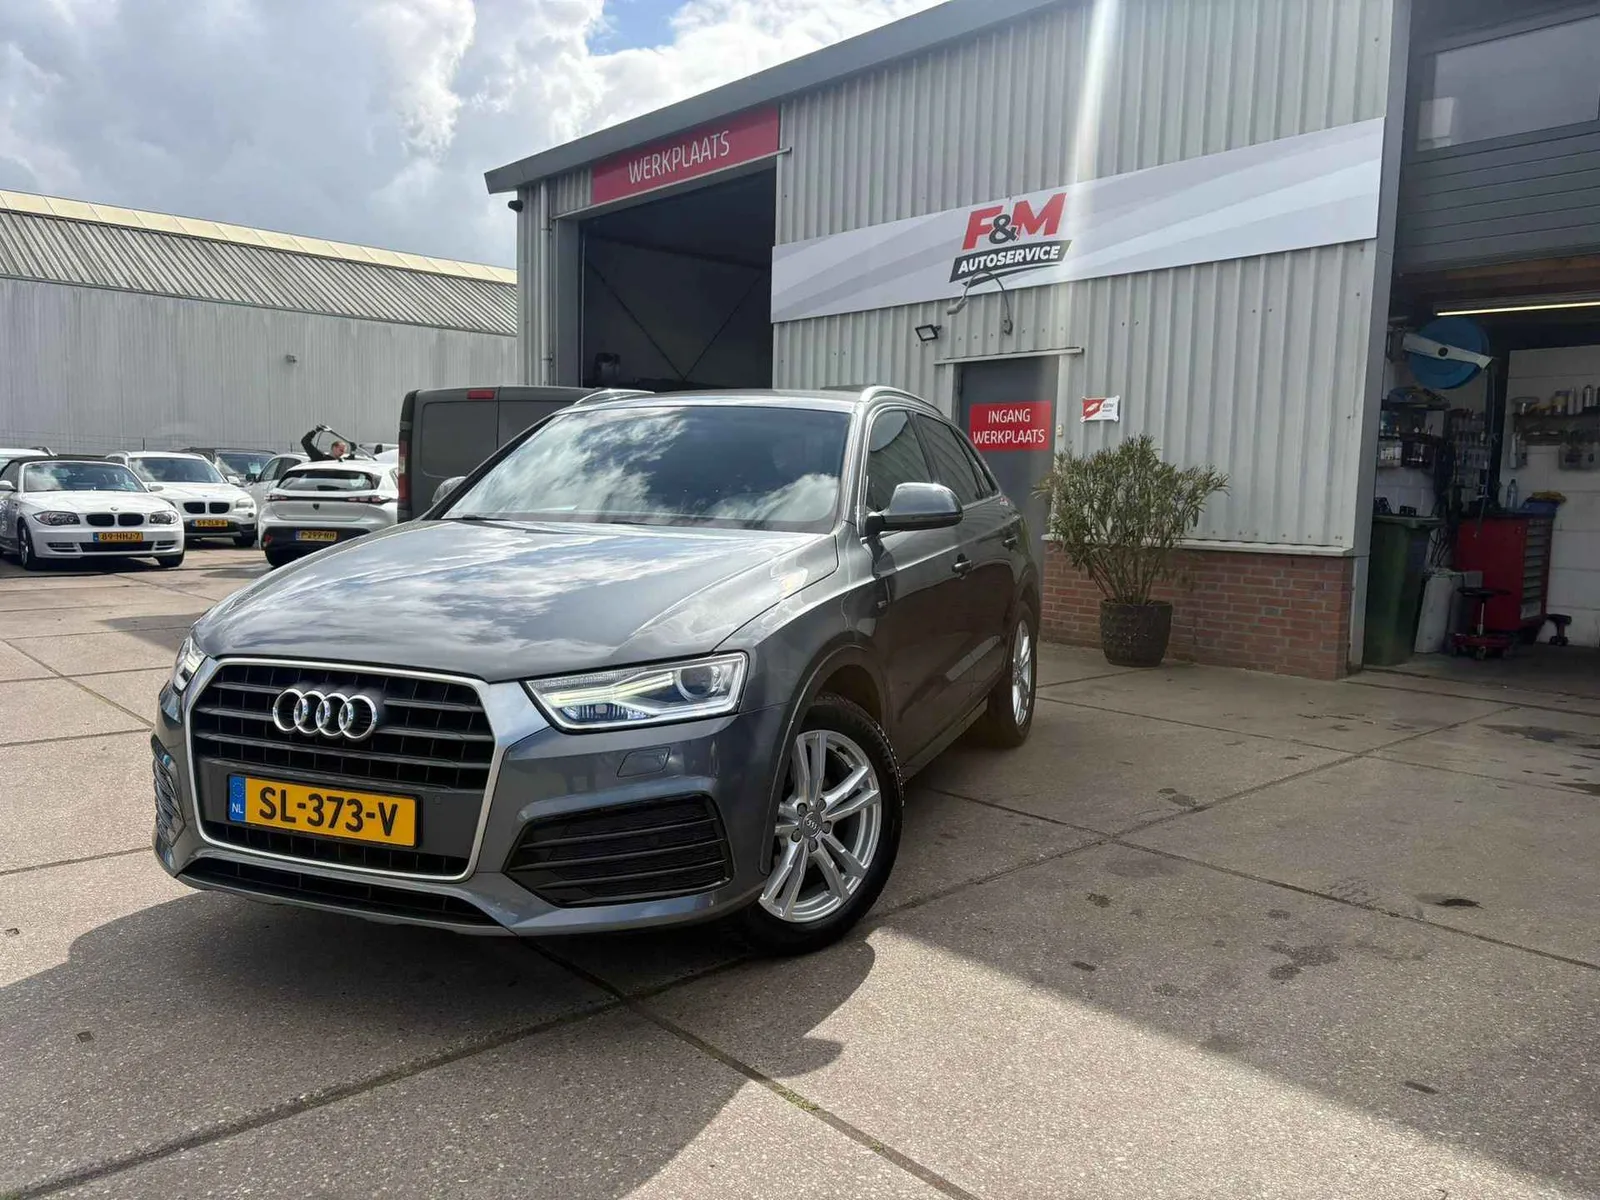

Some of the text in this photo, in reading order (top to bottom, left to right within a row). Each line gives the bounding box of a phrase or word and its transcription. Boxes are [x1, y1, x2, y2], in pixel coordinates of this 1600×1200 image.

[628, 130, 730, 184] WERKPLAATS
[962, 192, 1067, 250] F&M
[957, 245, 1061, 275] AUTOSERVICE
[973, 429, 1046, 444] WERKPLAATS
[988, 409, 1031, 423] INGANG
[231, 785, 399, 837] NL SL-373-V
